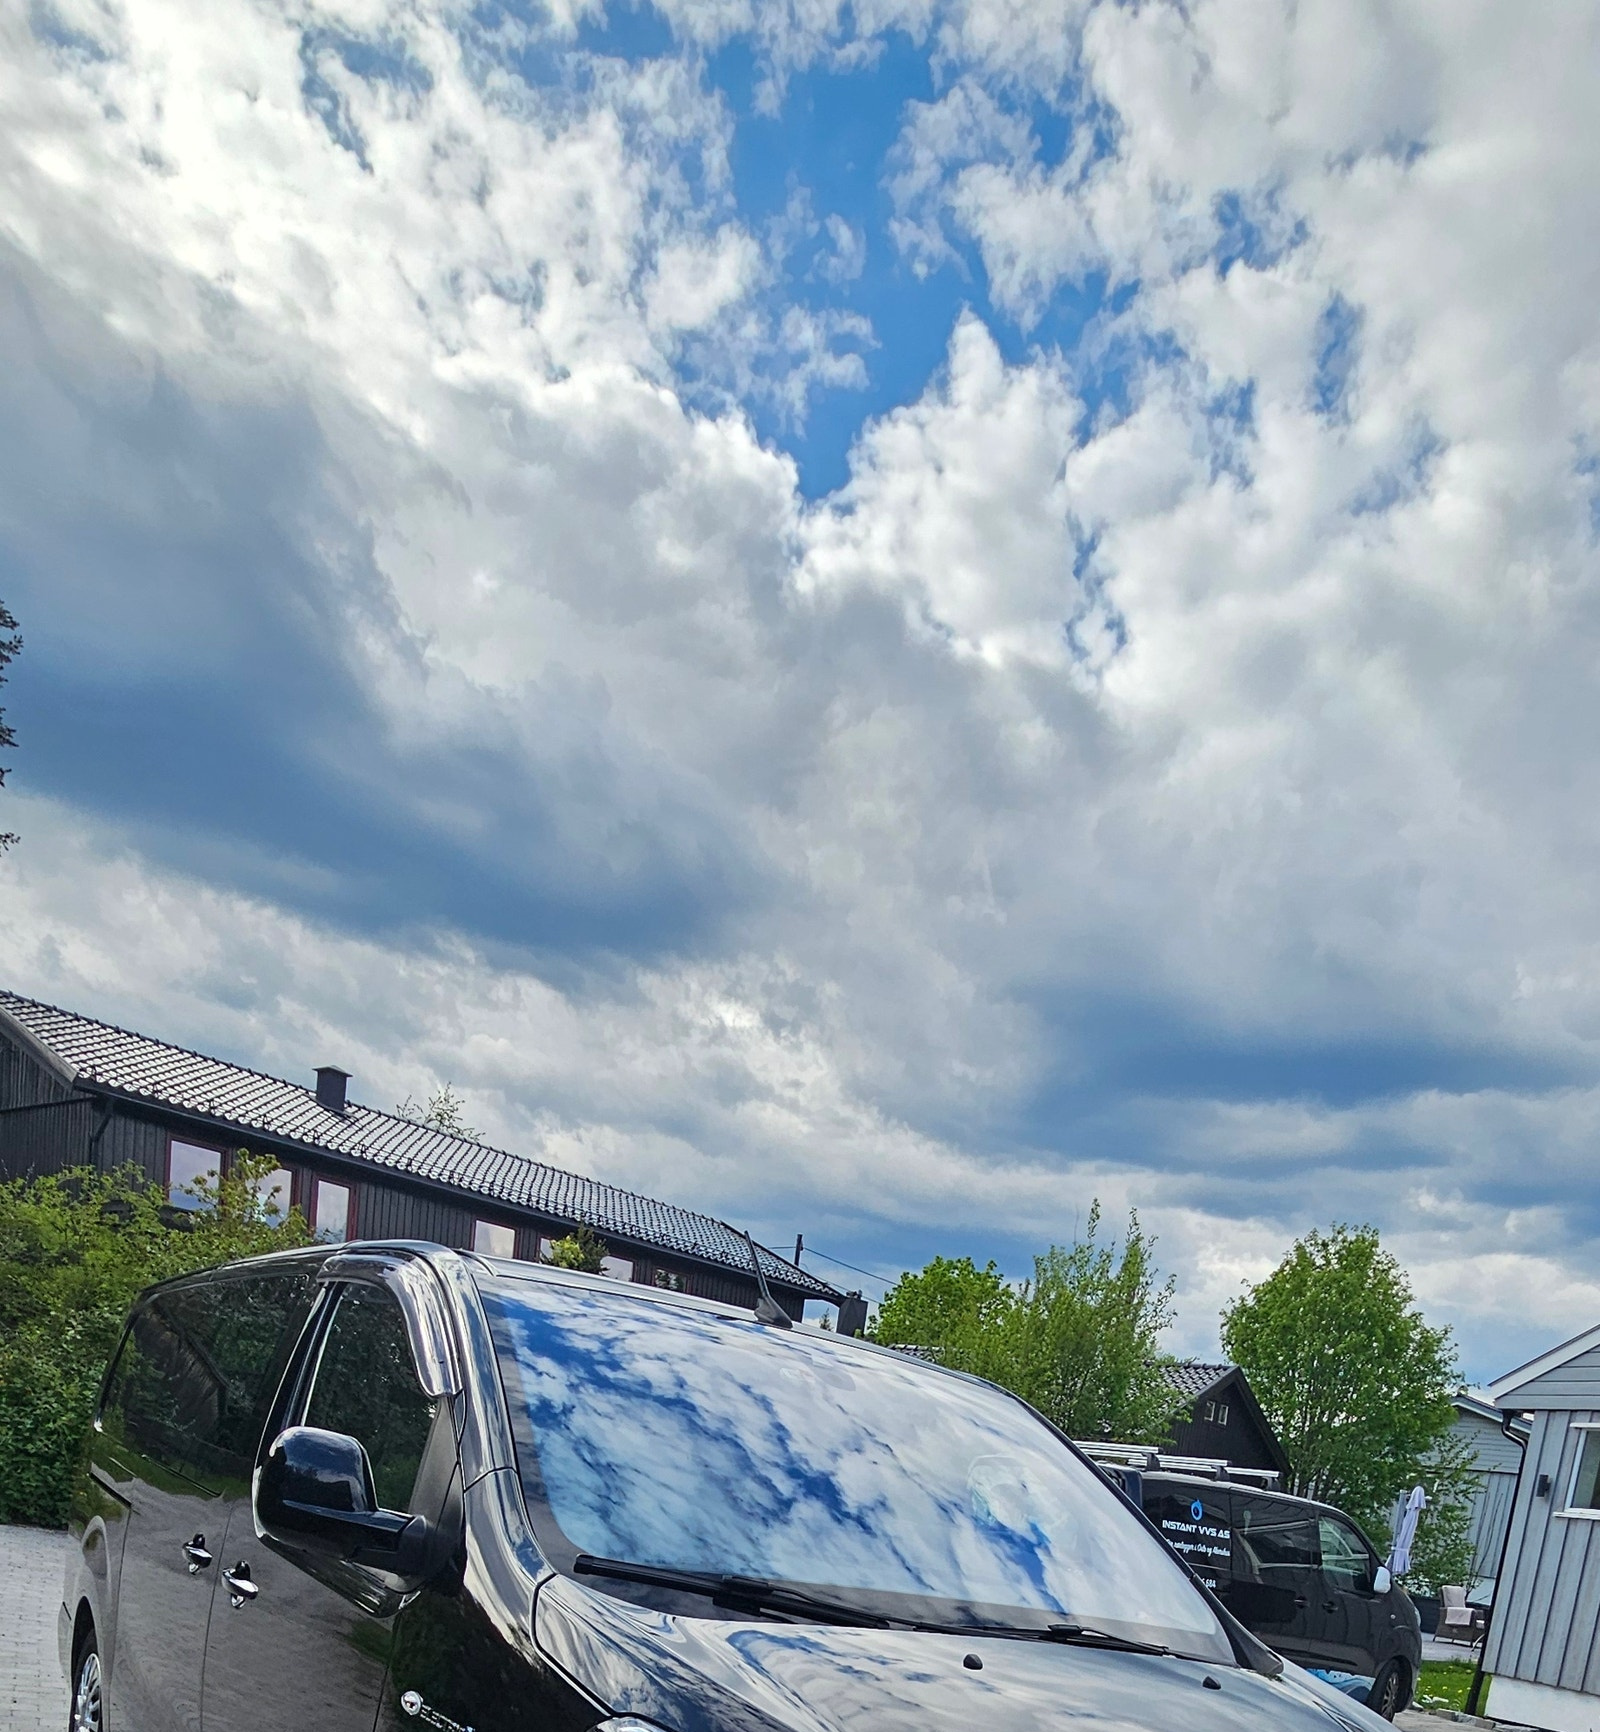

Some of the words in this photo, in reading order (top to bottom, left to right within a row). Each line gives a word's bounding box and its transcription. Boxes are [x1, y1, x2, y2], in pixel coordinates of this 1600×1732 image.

[1162, 1519, 1197, 1533] INSTANT
[1198, 1525, 1217, 1537] VVS
[1217, 1529, 1231, 1539] AS
